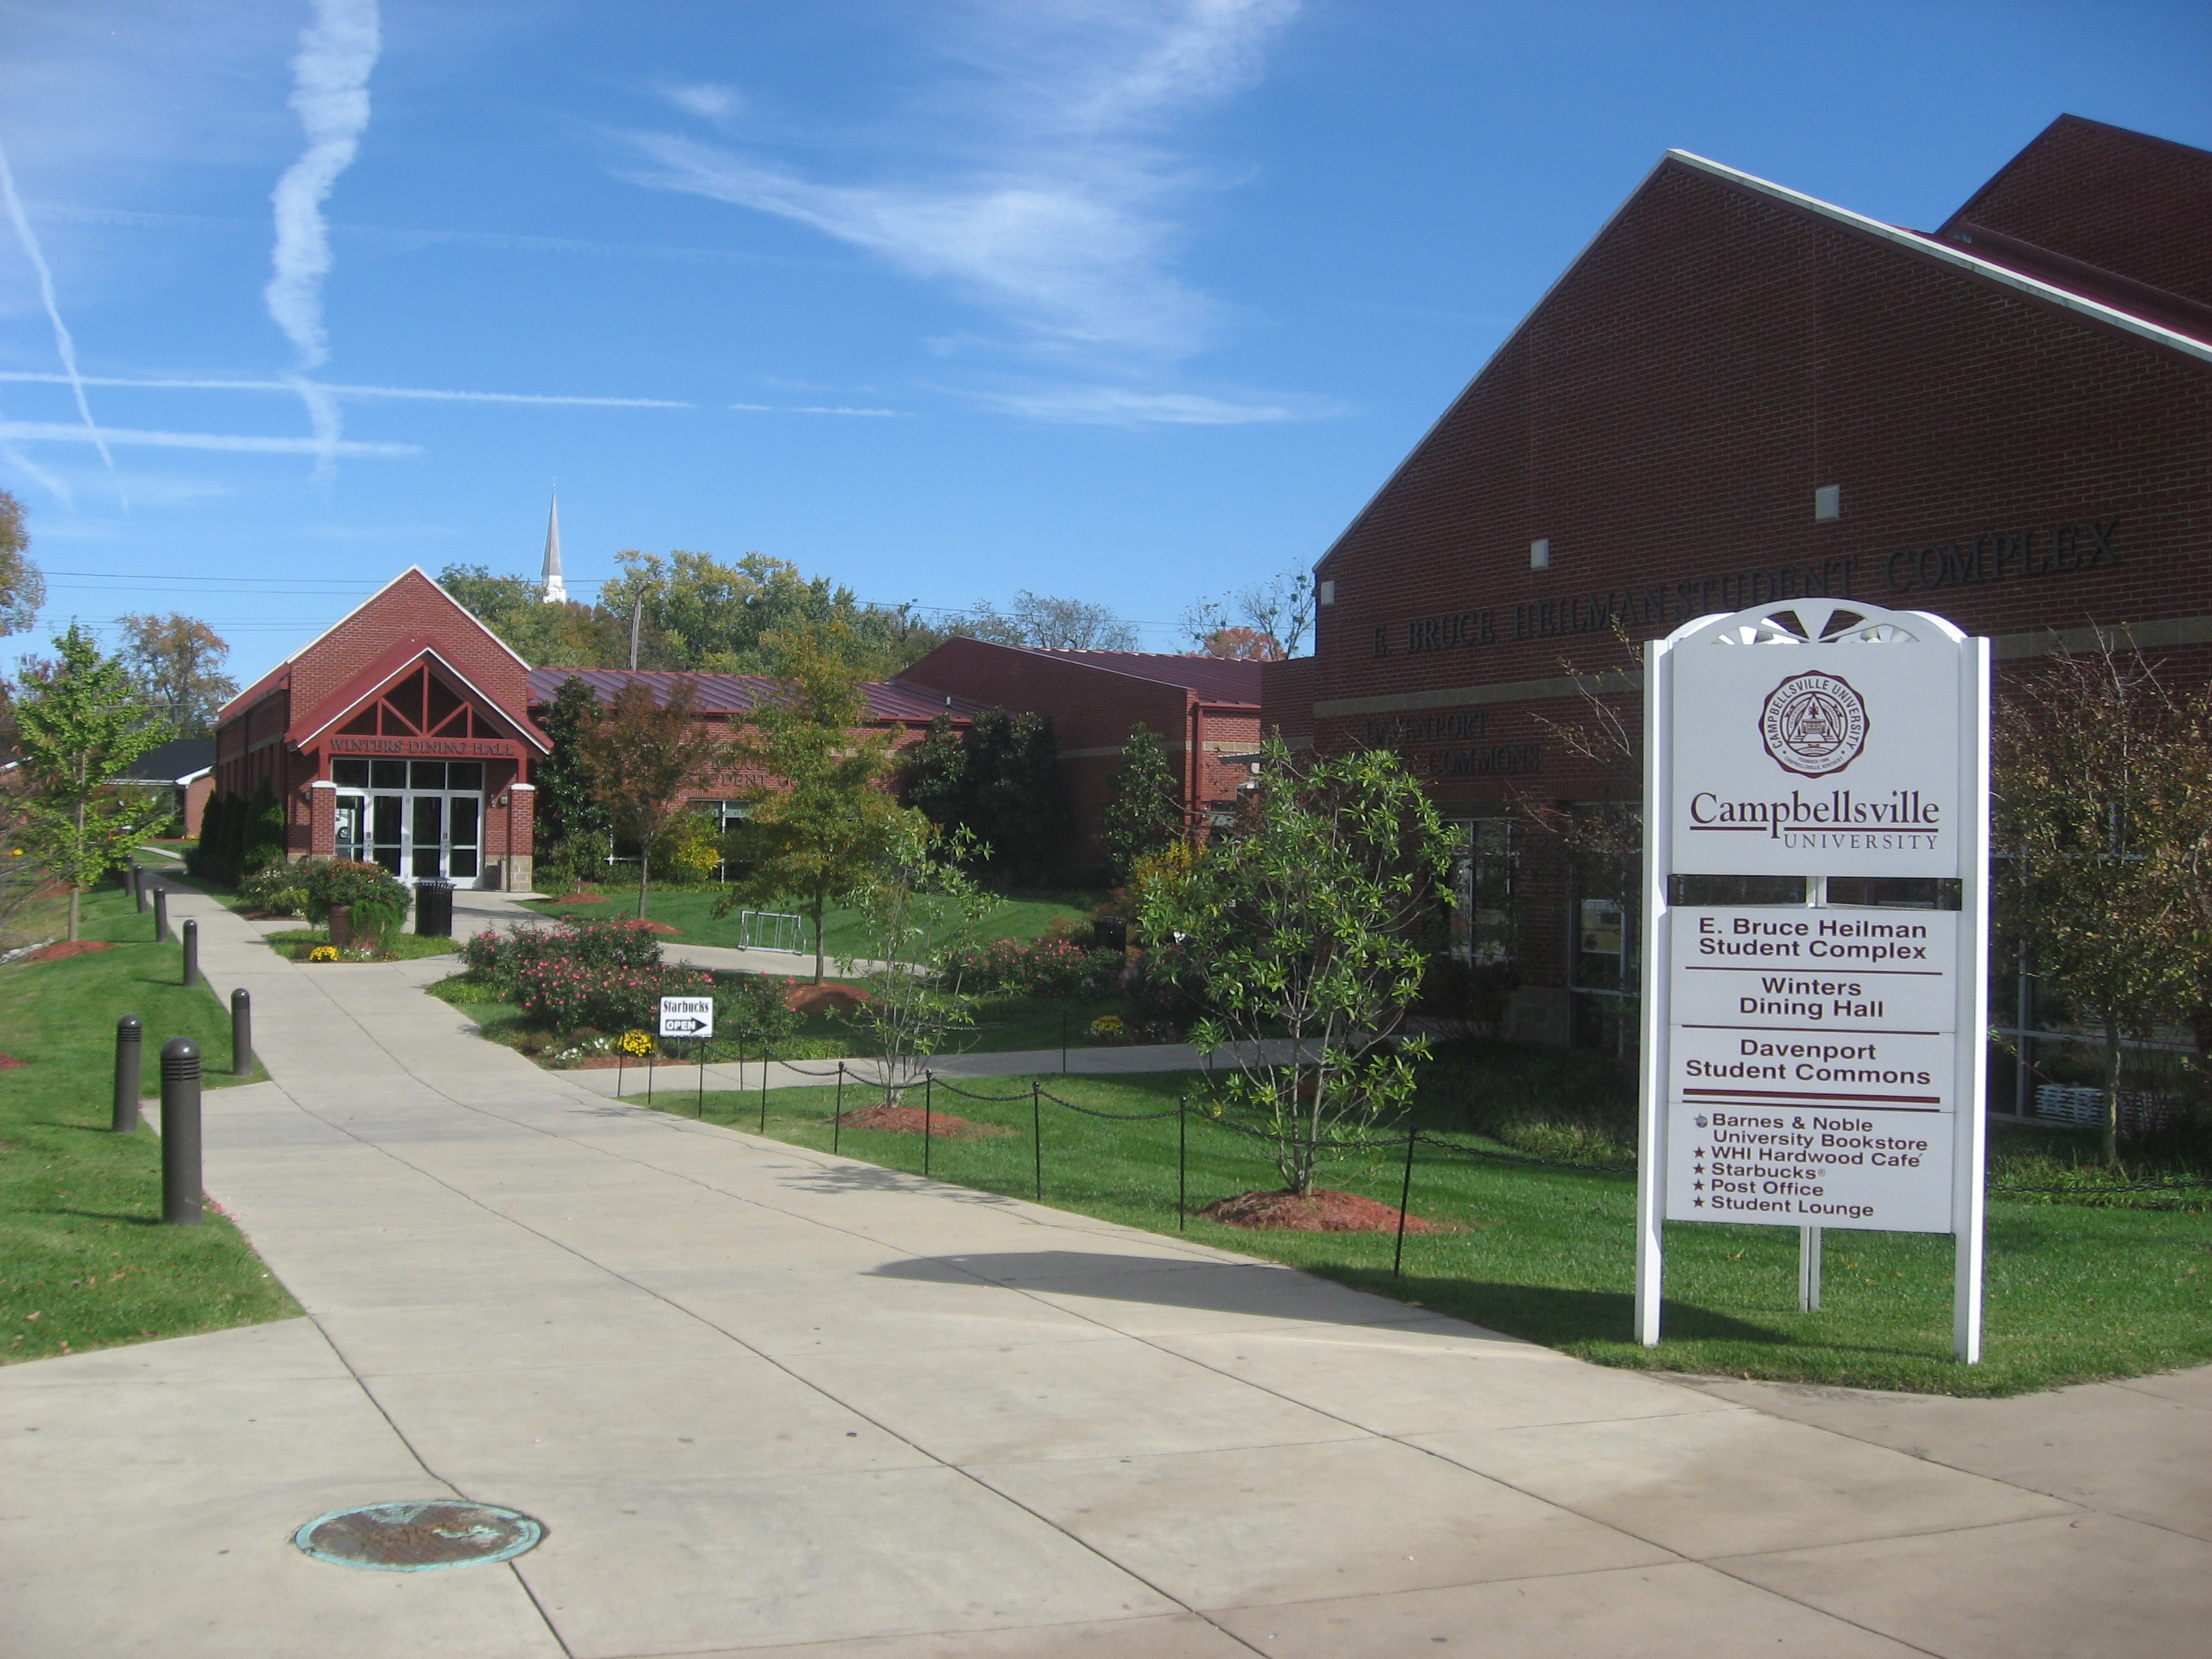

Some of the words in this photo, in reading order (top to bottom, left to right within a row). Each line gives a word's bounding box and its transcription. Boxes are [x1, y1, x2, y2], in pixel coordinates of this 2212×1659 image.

[1407, 608, 1496, 653] BRUCE
[1513, 584, 1666, 640] HEILMAN
[1884, 519, 2121, 594] COMPLEX
[1767, 678, 1830, 749] CAMPBELLSVILLE
[1831, 683, 1862, 750] UNIVERSITY
[329, 738, 404, 753] WINTERS
[408, 741, 467, 756] DINING
[473, 743, 516, 756] HALL
[1690, 789, 1939, 840] Campbellsville
[1784, 833, 1938, 851] UNIVERSITY
[1698, 917, 1723, 935] E.
[1733, 917, 1810, 936] Bruce
[1818, 919, 1928, 939] Heilman
[1698, 938, 1801, 958] Student
[1809, 939, 1928, 963] Complex
[1761, 976, 1862, 997] Winters
[662, 1000, 709, 1013] Starbucks
[1739, 997, 1824, 1020] Dining
[1833, 999, 1884, 1018] Hall
[666, 1020, 696, 1031] OPEN
[1740, 1038, 1877, 1063] Davenport
[1686, 1060, 1787, 1081] Student
[1795, 1063, 1932, 1086] Commons
[1712, 1112, 1785, 1130] Barnes
[1791, 1115, 1806, 1131] &
[1812, 1116, 1873, 1133] Noble
[1712, 1129, 1815, 1150] University
[1821, 1133, 1928, 1152] Bookstore
[1711, 1146, 1752, 1161] WHI
[1759, 1148, 1864, 1166] Hardwood
[1711, 1179, 1756, 1195] Post
[1763, 1181, 1825, 1197] Office
[1711, 1196, 1792, 1214] Student
[1798, 1199, 1875, 1219] Lounge
